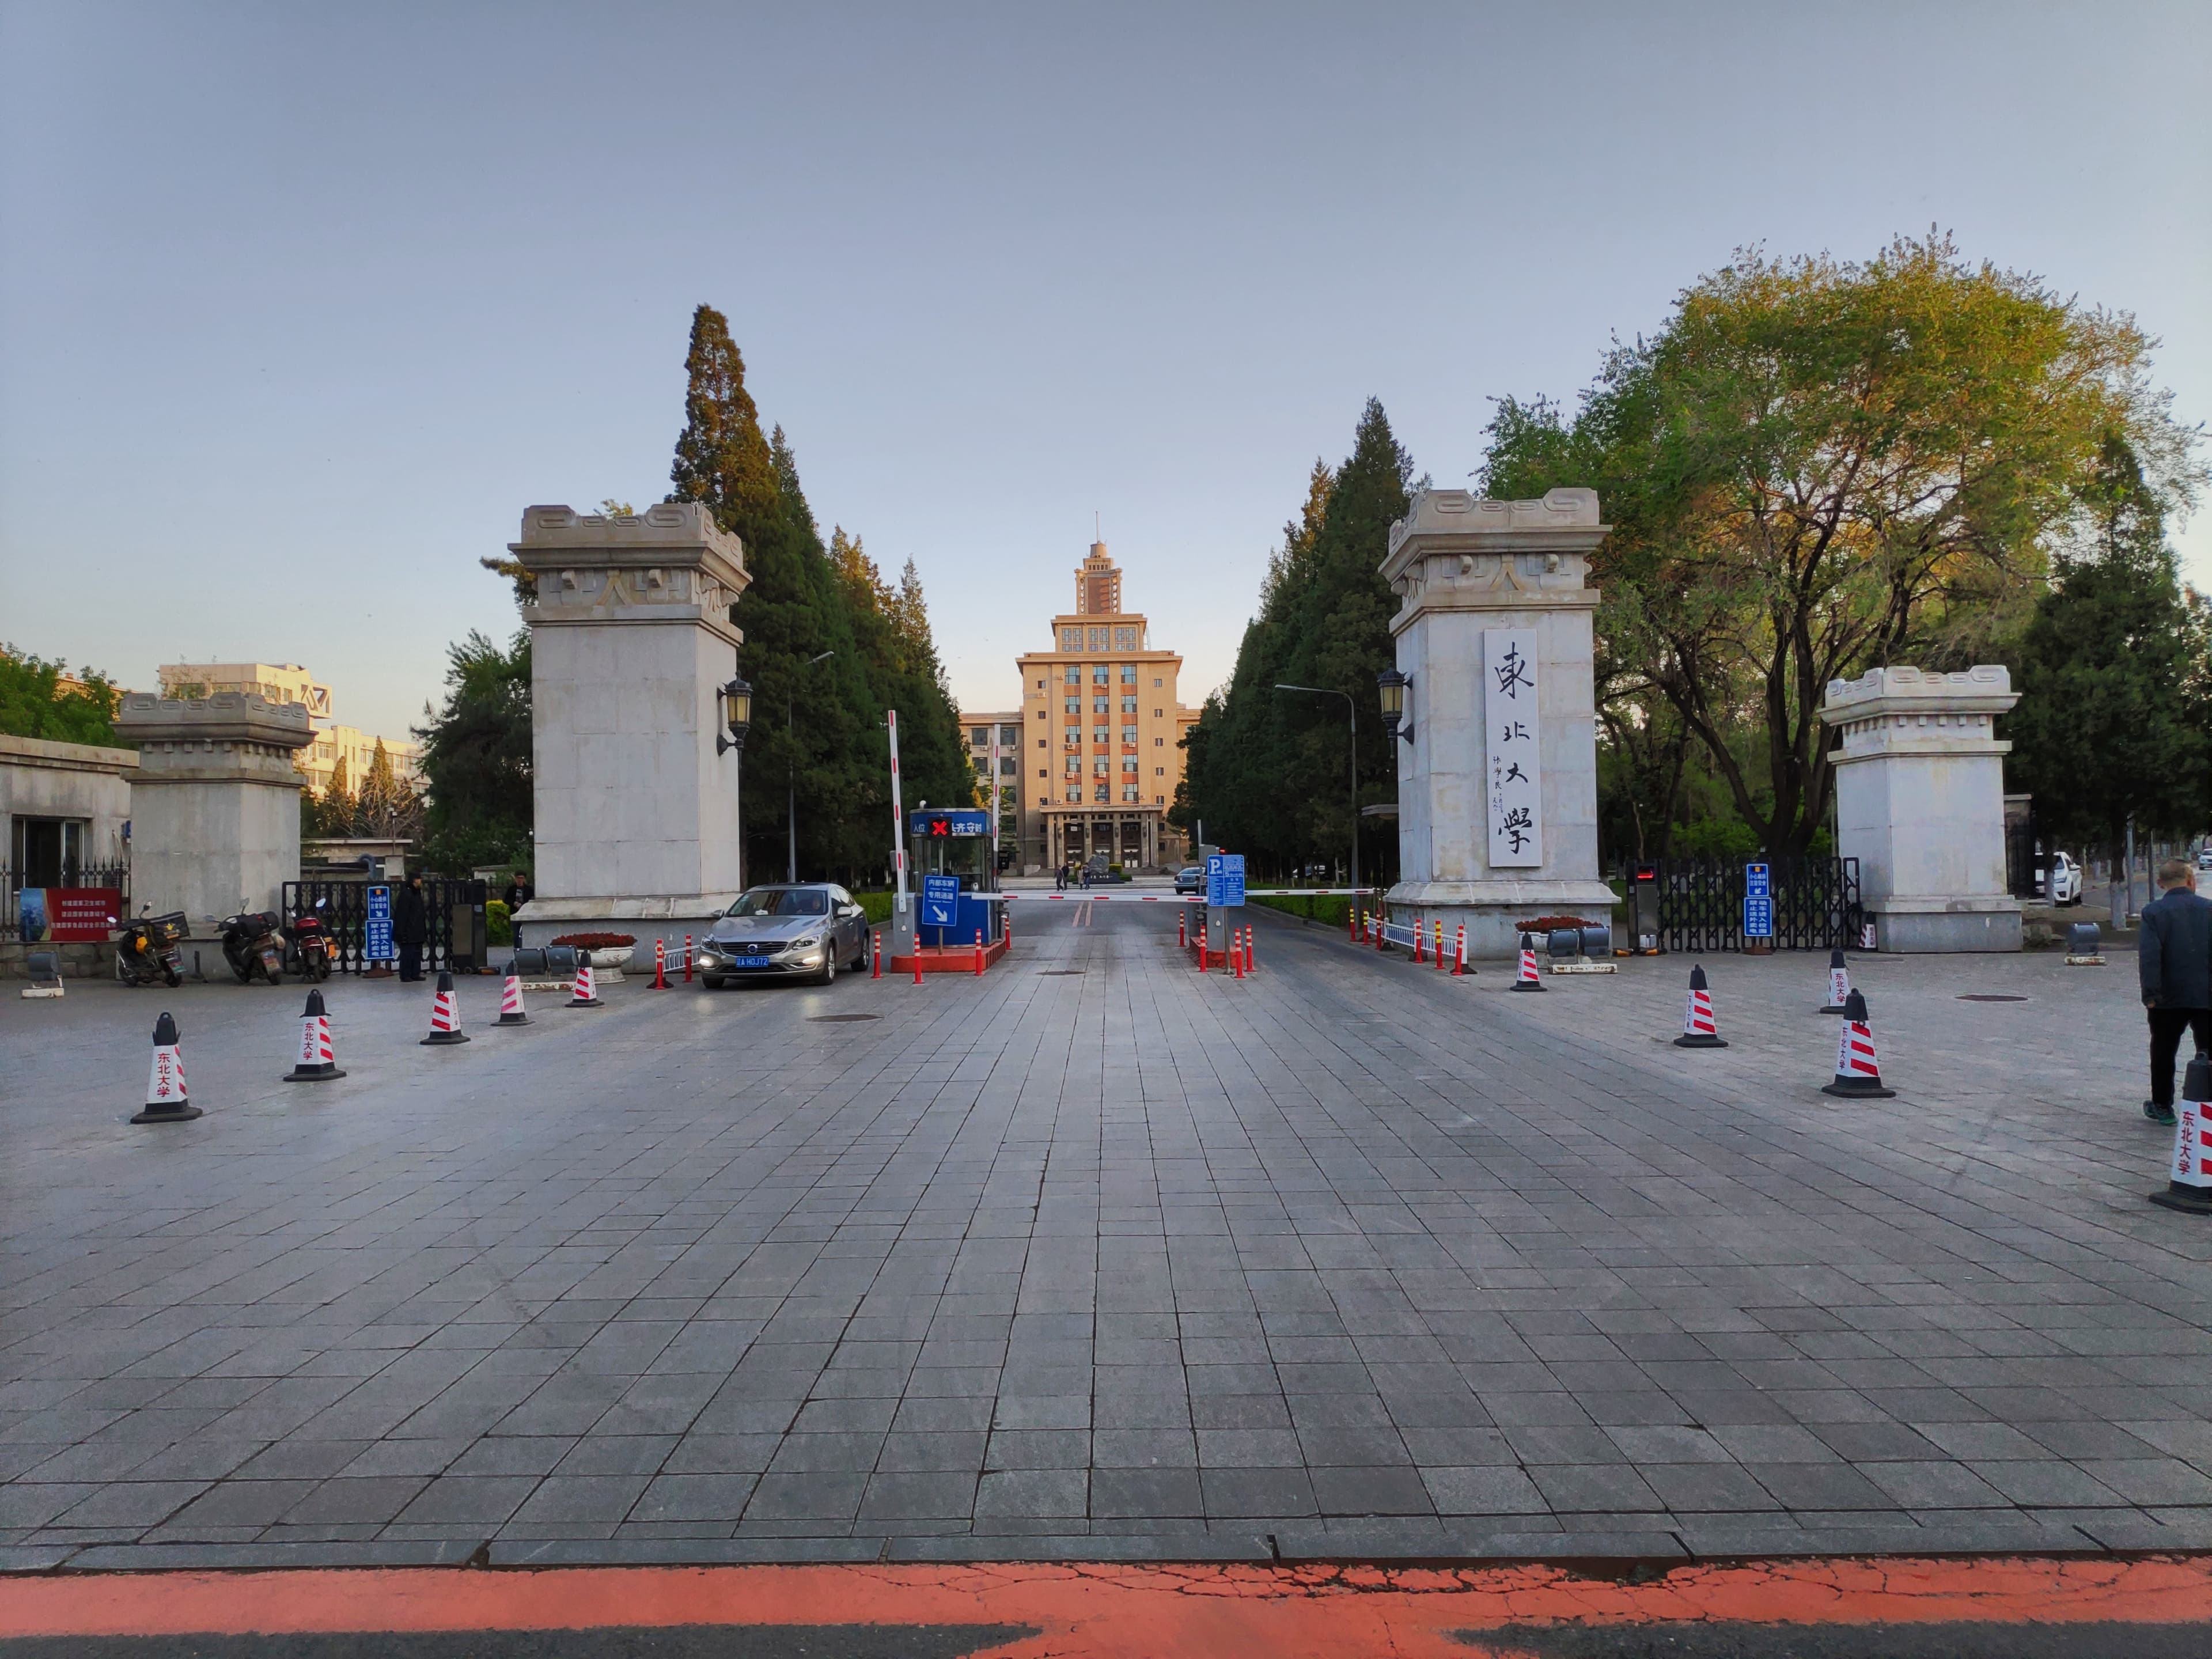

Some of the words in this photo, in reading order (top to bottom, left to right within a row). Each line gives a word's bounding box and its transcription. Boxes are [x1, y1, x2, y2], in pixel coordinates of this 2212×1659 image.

[1494, 641, 1535, 854] 東北大學
[1210, 858, 1221, 874] P
[927, 891, 954, 900] 专用通道
[929, 879, 955, 888] 内部车辆
[1835, 973, 1846, 1003] 东北大学
[303, 1022, 315, 1060] 东北大学
[157, 1052, 171, 1098] 东北大学
[2178, 1111, 2195, 1175] 东北大学
